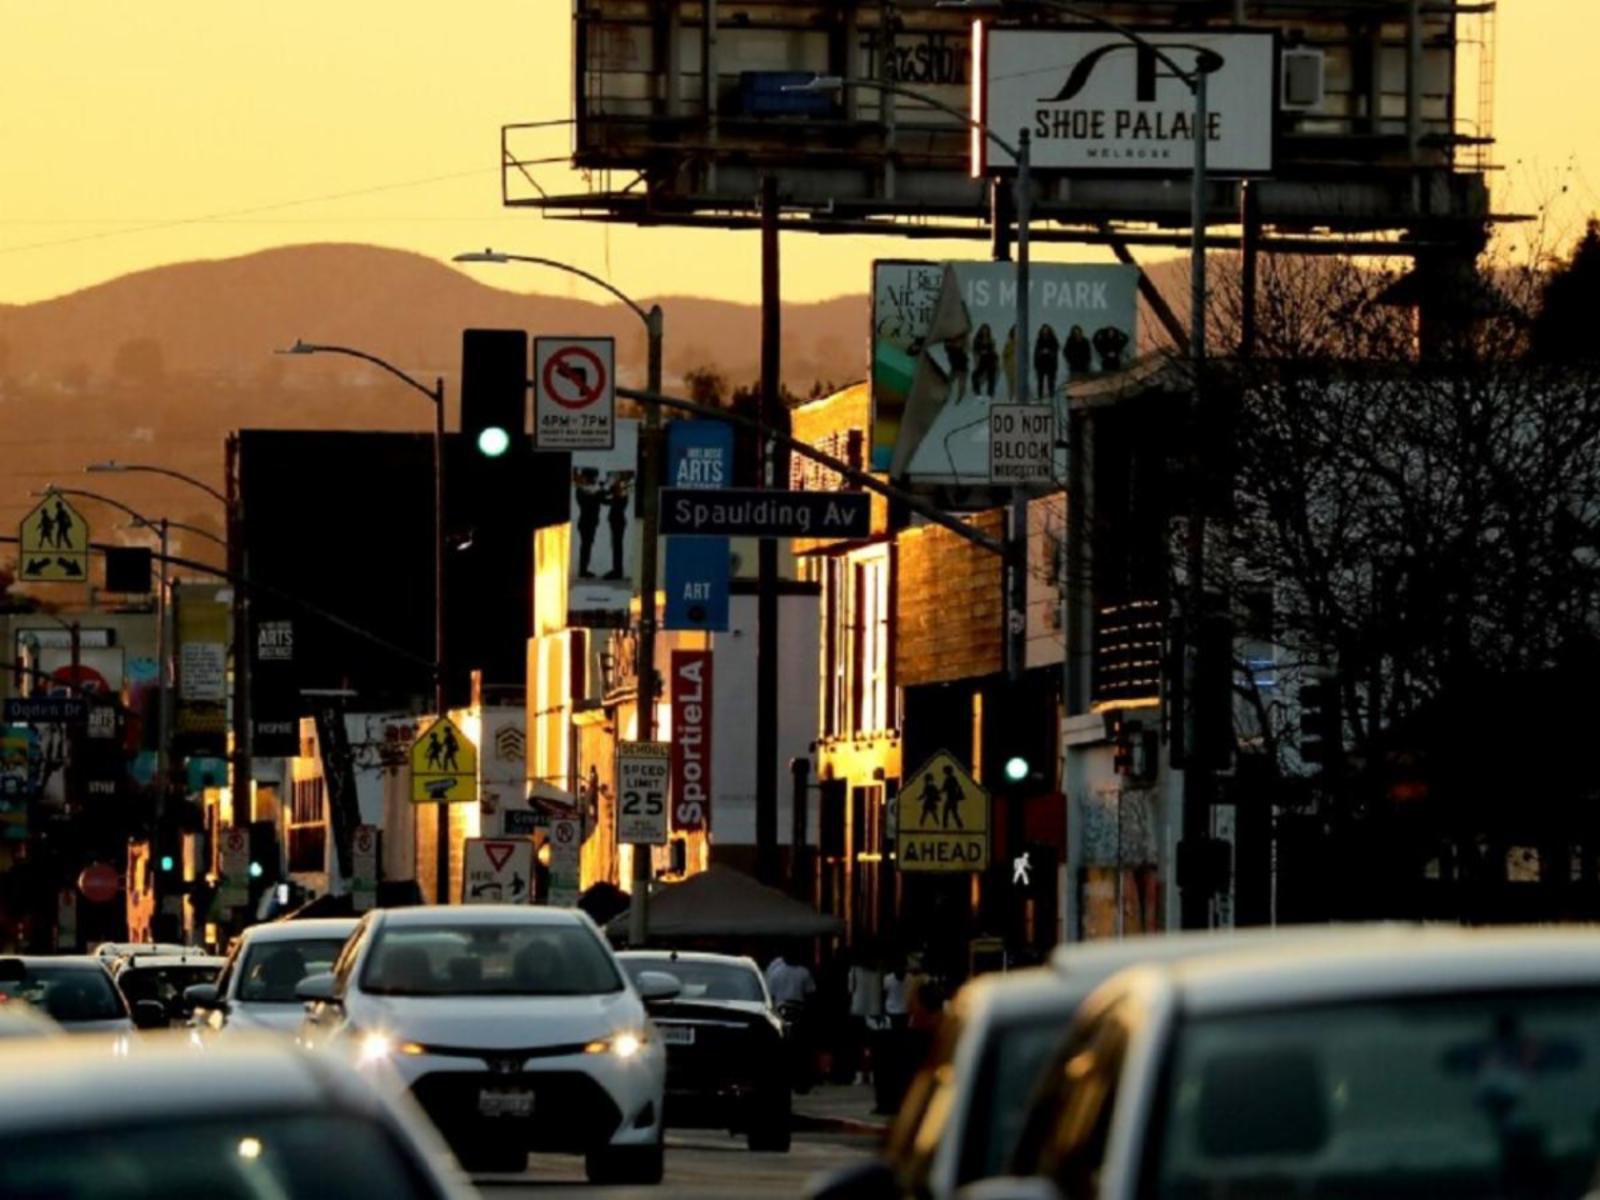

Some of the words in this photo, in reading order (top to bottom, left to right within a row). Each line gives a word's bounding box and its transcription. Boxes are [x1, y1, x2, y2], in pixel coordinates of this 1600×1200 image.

[1036, 110, 1104, 140] SHOE
[1116, 110, 1222, 140] PALAE
[1087, 149, 1171, 159] MELROSE
[1043, 282, 1109, 309] PARK
[994, 414, 1014, 433] DO
[1022, 415, 1050, 433] NOT
[994, 441, 1049, 459] BLOCK
[676, 459, 723, 482] ARTS
[675, 500, 811, 531] Spaulding
[823, 502, 857, 526] Av
[683, 581, 711, 600] ART
[257, 630, 293, 646] ARTS
[677, 660, 706, 824] SportieLA
[623, 765, 666, 776] SPEED
[626, 778, 659, 788] LIMIT
[623, 792, 663, 815] 25
[904, 842, 981, 862] AHEAD
